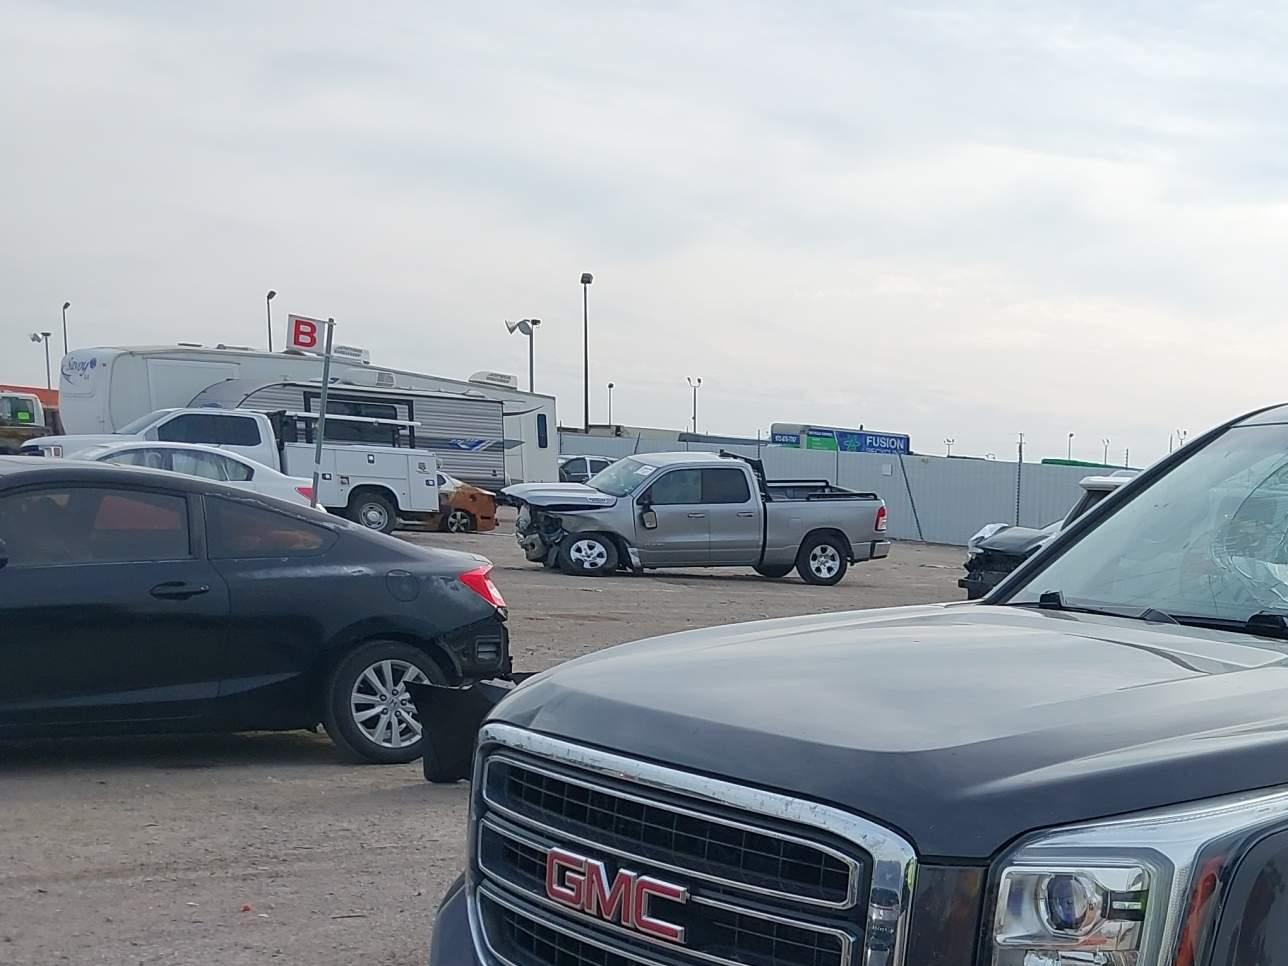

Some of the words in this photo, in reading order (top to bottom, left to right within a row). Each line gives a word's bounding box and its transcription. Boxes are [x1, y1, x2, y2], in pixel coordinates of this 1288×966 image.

[294, 320, 316, 347] B
[866, 436, 904, 449] FUSION
[546, 847, 688, 944] GMC
